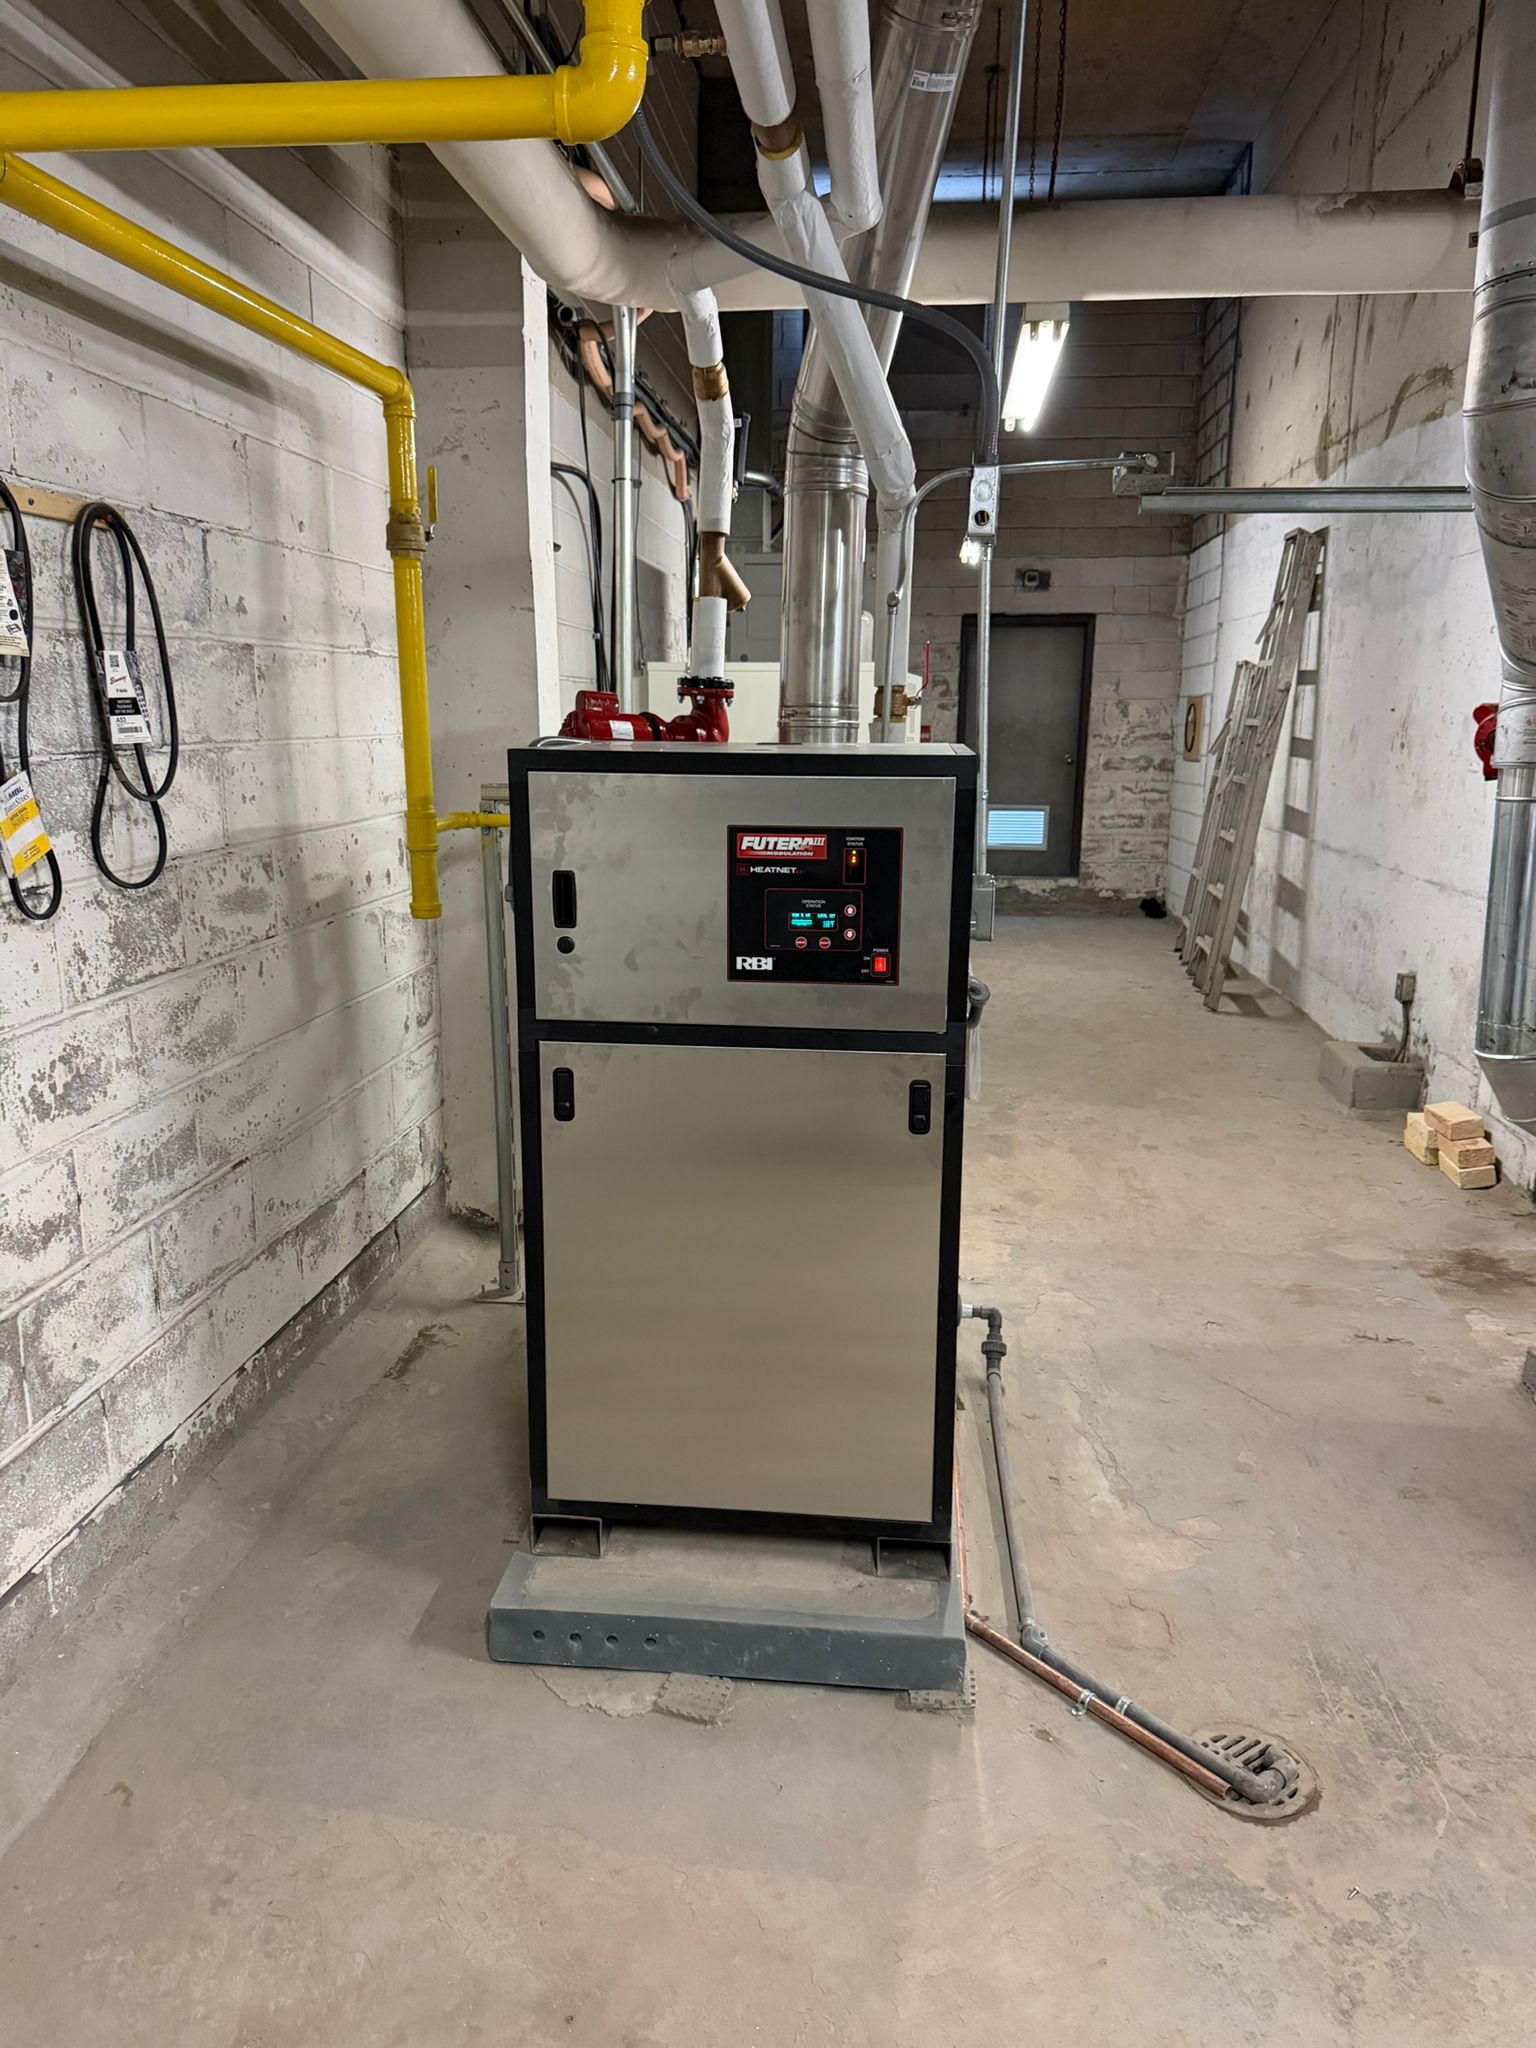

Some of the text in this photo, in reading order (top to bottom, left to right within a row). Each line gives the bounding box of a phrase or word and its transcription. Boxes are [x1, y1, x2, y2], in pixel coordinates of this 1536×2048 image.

[8, 786, 25, 800] MBL
[750, 866, 798, 874] HEATNET
[736, 956, 773, 971] RBI
